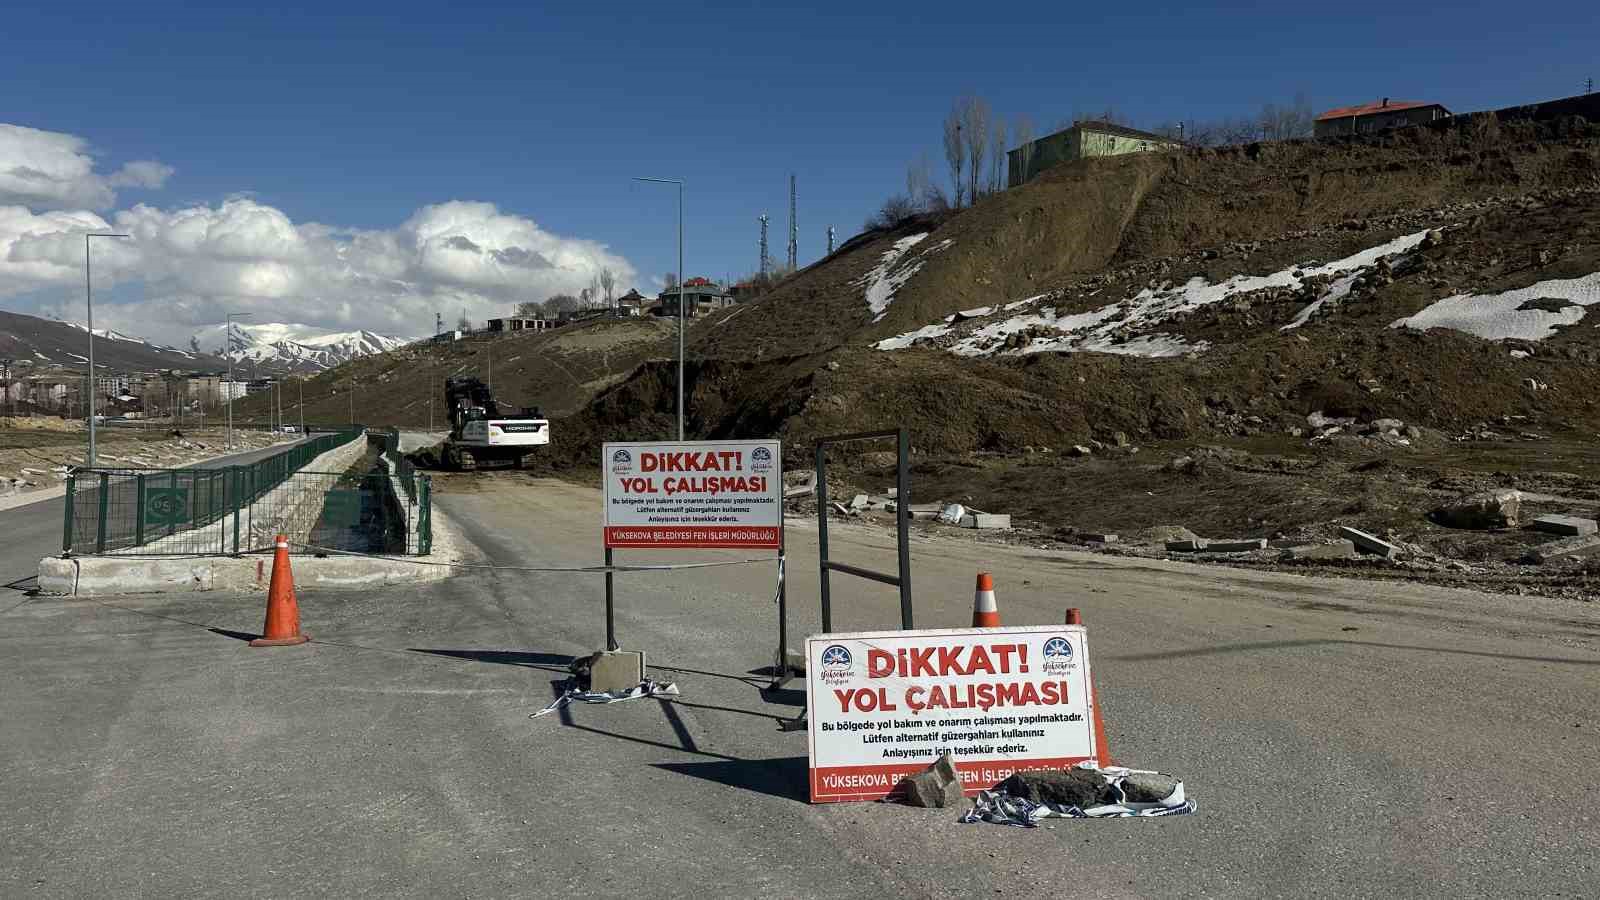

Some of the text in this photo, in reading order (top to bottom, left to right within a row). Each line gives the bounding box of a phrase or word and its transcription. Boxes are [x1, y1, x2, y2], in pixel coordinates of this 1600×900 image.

[640, 451, 743, 473] DİKKAT!
[620, 476, 767, 495] YOL ÇALIŞMASI
[612, 529, 775, 541] YÜKSEKOVA BELEDİYESİ FEN İŞLERİ MÜDÜRLÜĞÜ
[867, 643, 1029, 679] DİKKAT!
[834, 681, 1069, 716] YOL ÇALIŞMASI
[822, 712, 1084, 732] Bu bölgede yol bakım ve onarım çalışması yapılmaktadır.
[863, 728, 1045, 743] Lütfen alternatif güzergahları kullanınız
[882, 743, 1028, 759] Anlayışınız için teşekkür ederiz.
[822, 772, 888, 789] YÜKSEKOVA
